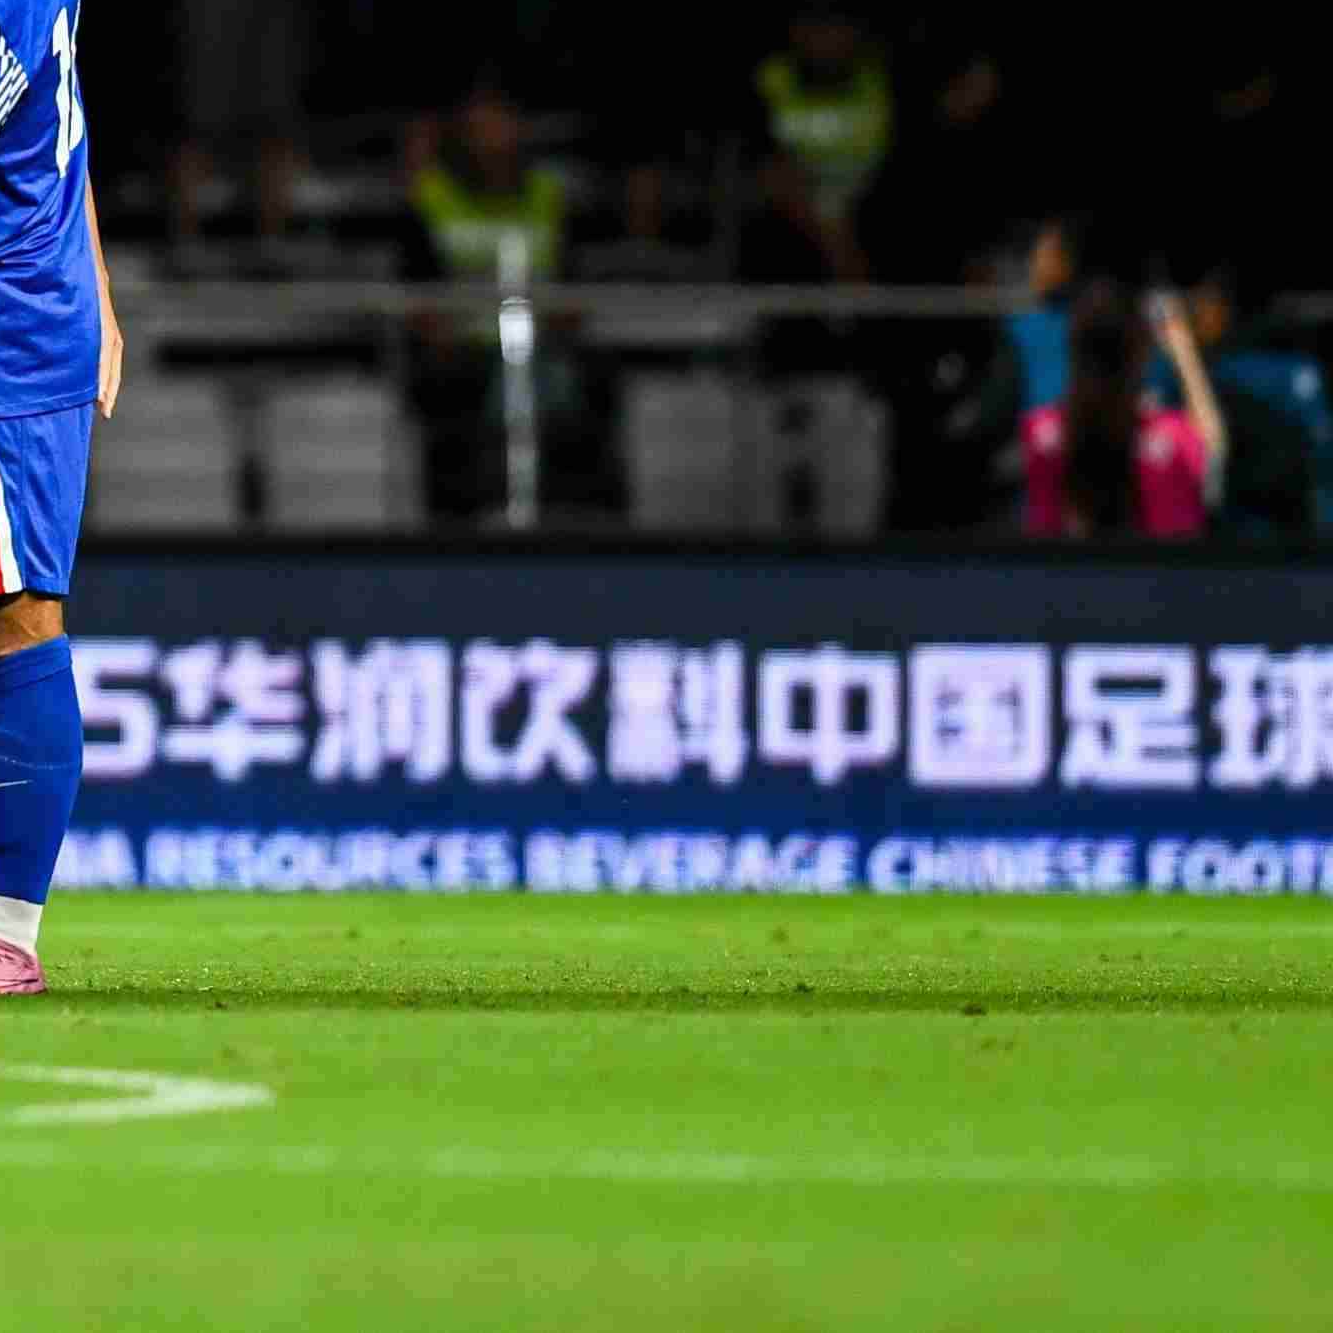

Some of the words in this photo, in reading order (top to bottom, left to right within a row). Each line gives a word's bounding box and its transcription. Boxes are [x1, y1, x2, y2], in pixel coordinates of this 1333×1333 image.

[525, 829, 859, 892] BEVERAGE
[866, 832, 1137, 894] CHINESE
[1146, 834, 1333, 895] FOOT
